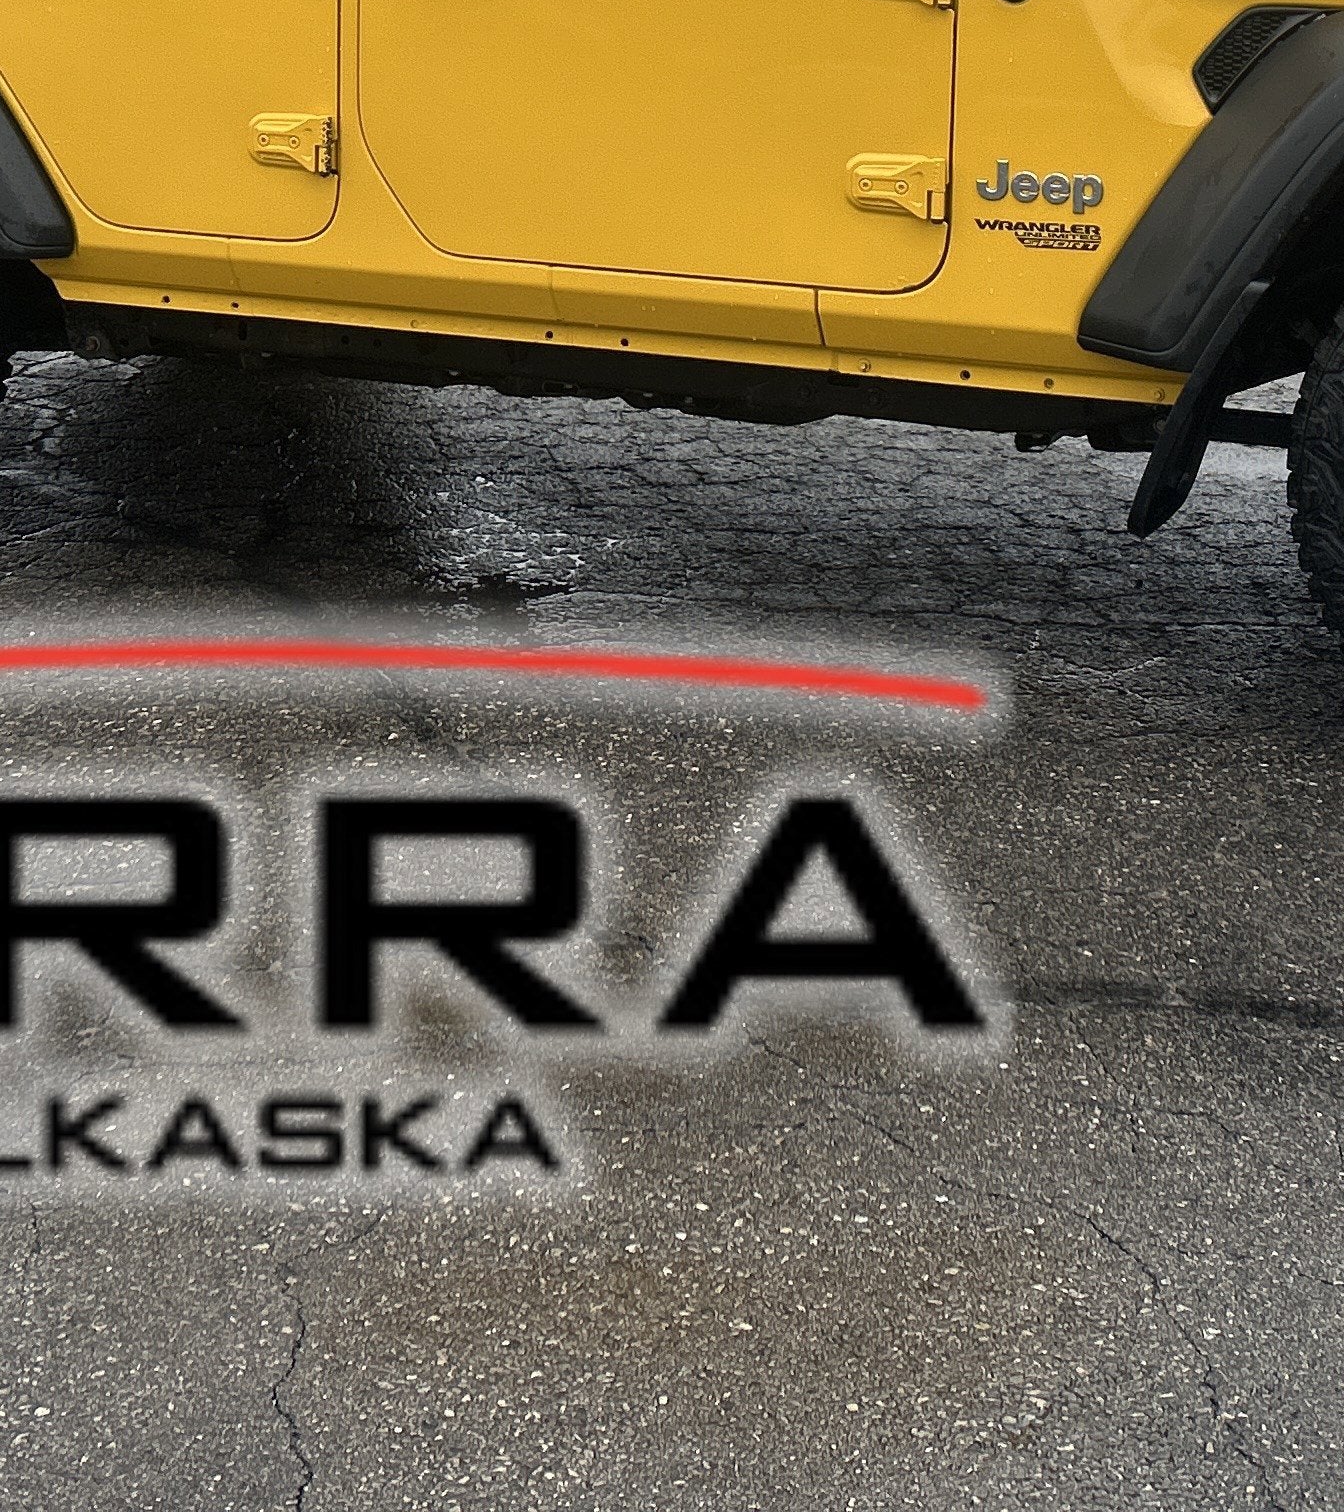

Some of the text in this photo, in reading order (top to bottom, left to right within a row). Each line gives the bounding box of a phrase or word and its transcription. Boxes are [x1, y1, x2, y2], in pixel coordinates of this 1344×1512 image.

[975, 159, 1104, 214] Jeep
[974, 218, 1101, 235] WRANGLER
[1023, 239, 1098, 249] SPORT
